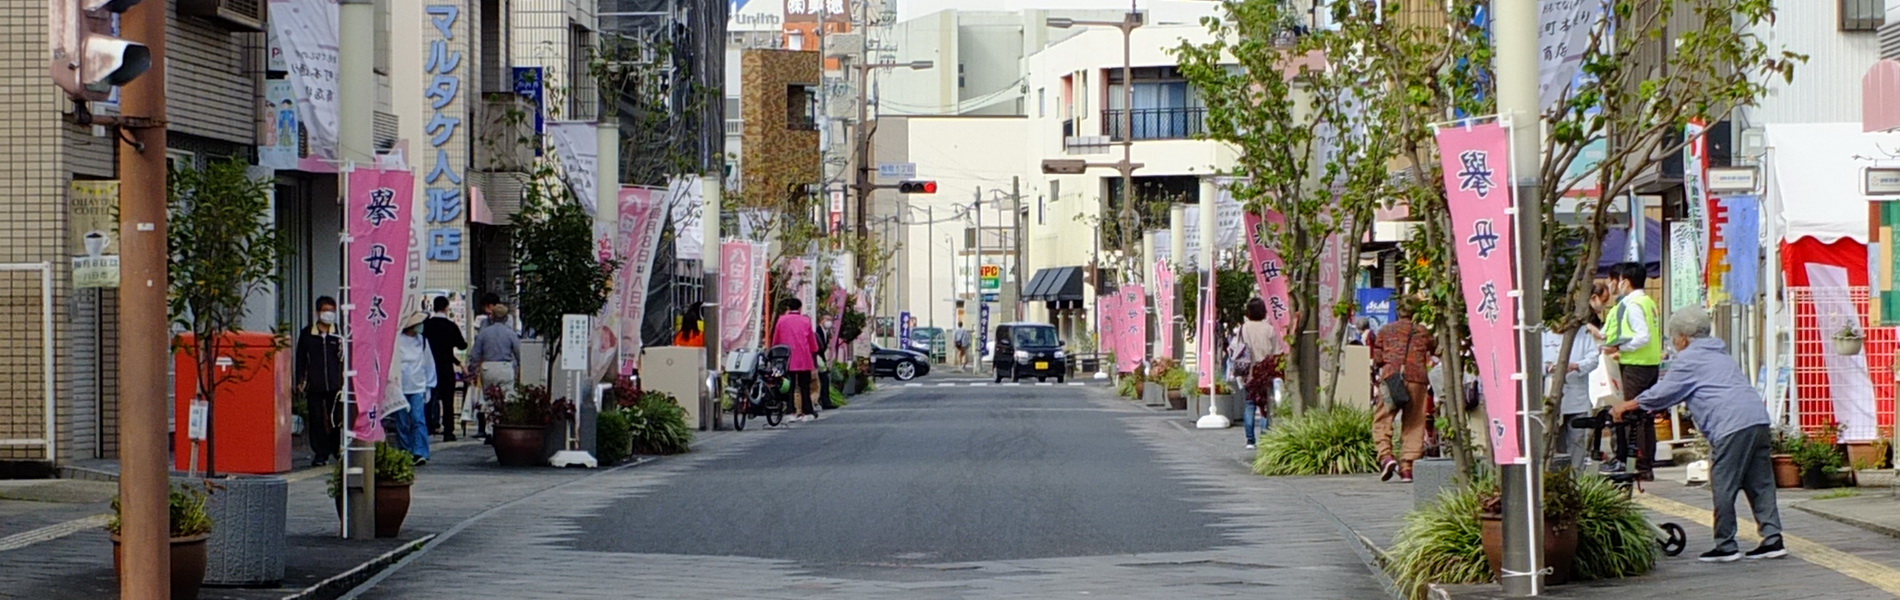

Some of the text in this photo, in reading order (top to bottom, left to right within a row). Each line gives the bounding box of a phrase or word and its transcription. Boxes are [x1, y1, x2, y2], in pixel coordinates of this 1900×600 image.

[424, 5, 462, 261] マルタケ人形店
